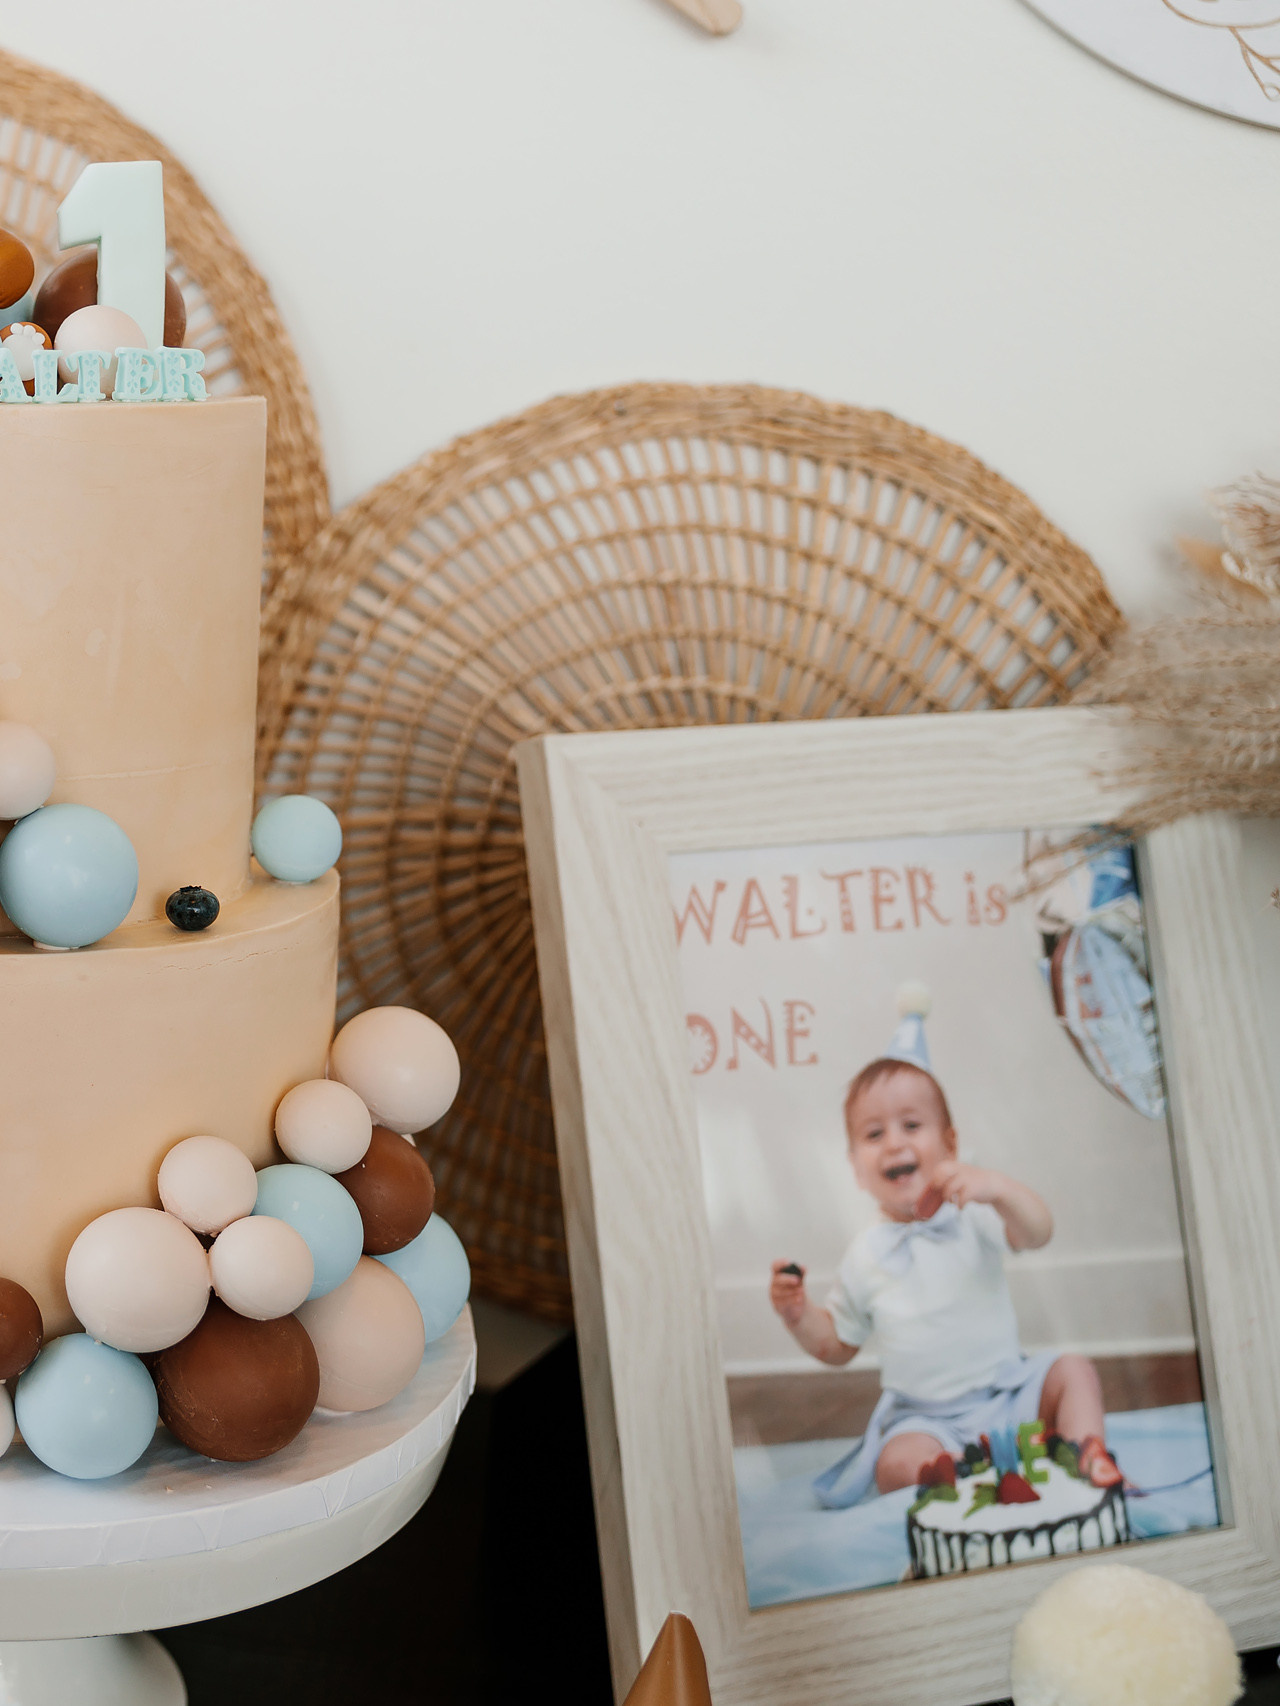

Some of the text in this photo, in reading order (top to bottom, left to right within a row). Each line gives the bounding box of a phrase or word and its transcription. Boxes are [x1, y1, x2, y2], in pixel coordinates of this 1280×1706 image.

[57, 160, 166, 352] 1
[671, 864, 1009, 946] WALTER is
